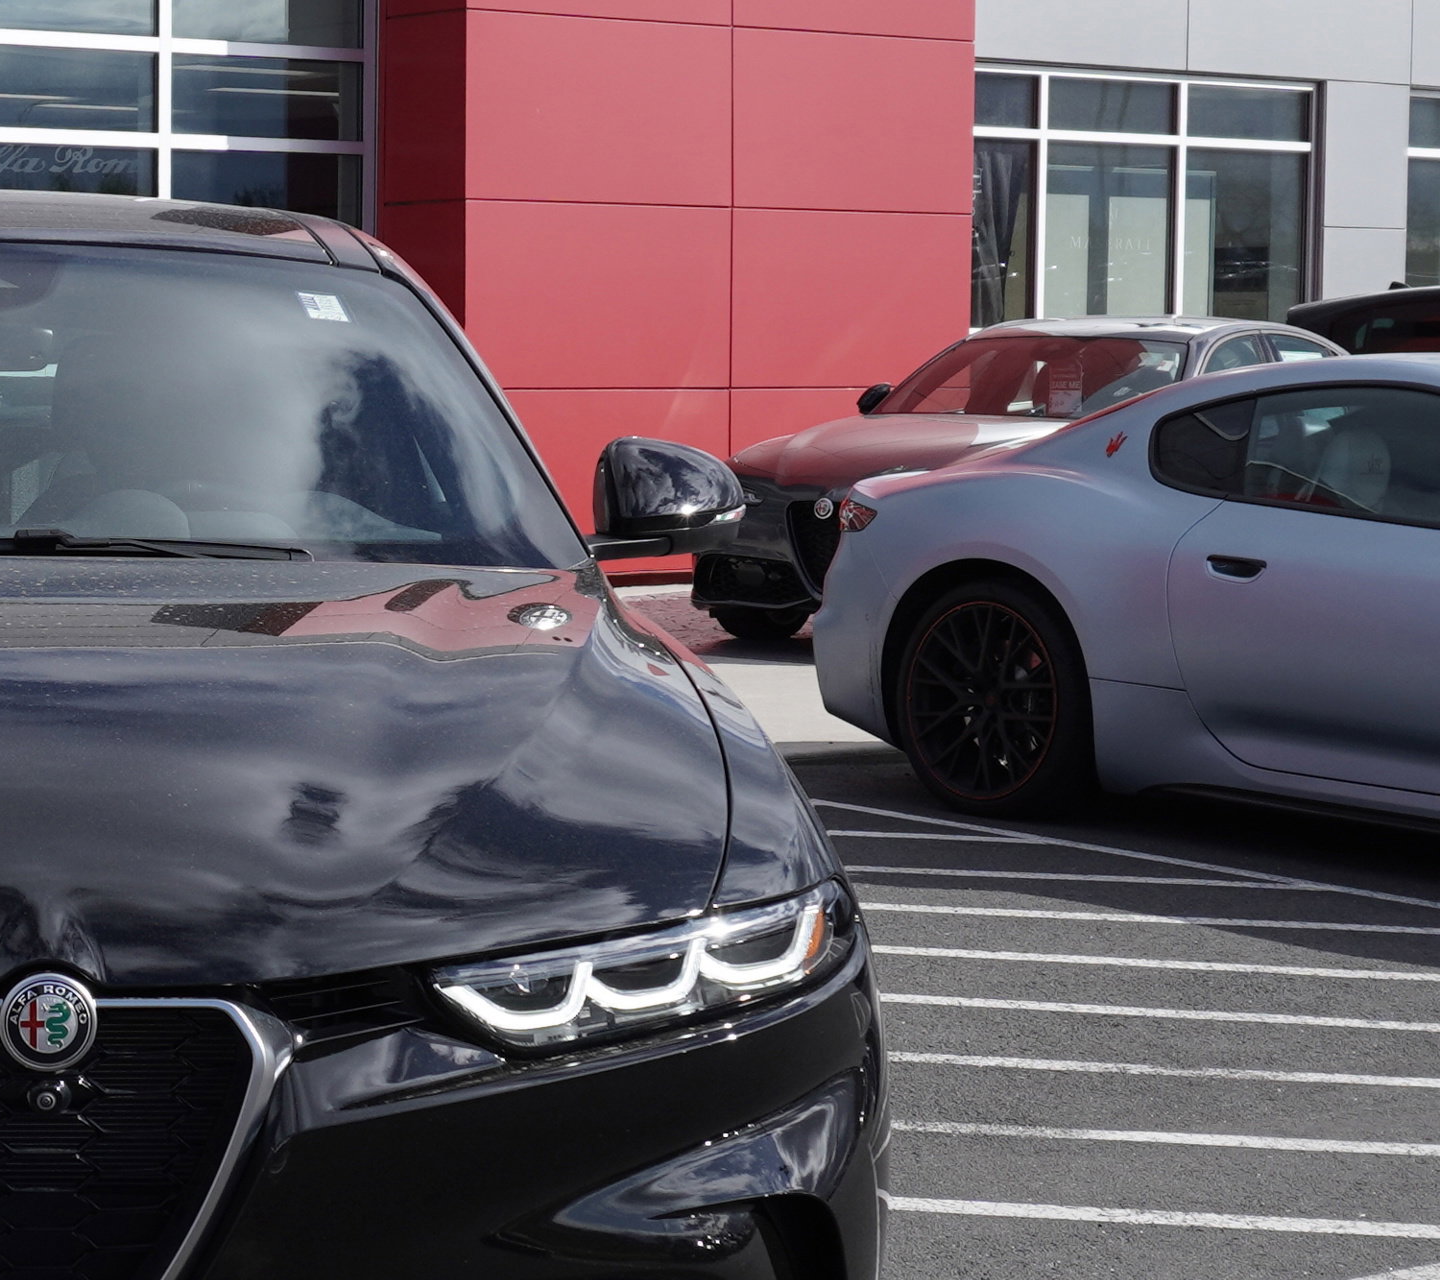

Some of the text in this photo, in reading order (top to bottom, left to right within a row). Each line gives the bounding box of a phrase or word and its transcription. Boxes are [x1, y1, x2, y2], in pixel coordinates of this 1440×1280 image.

[50, 145, 142, 174] Rom
[10, 985, 88, 1025] ALFA ROMEO
